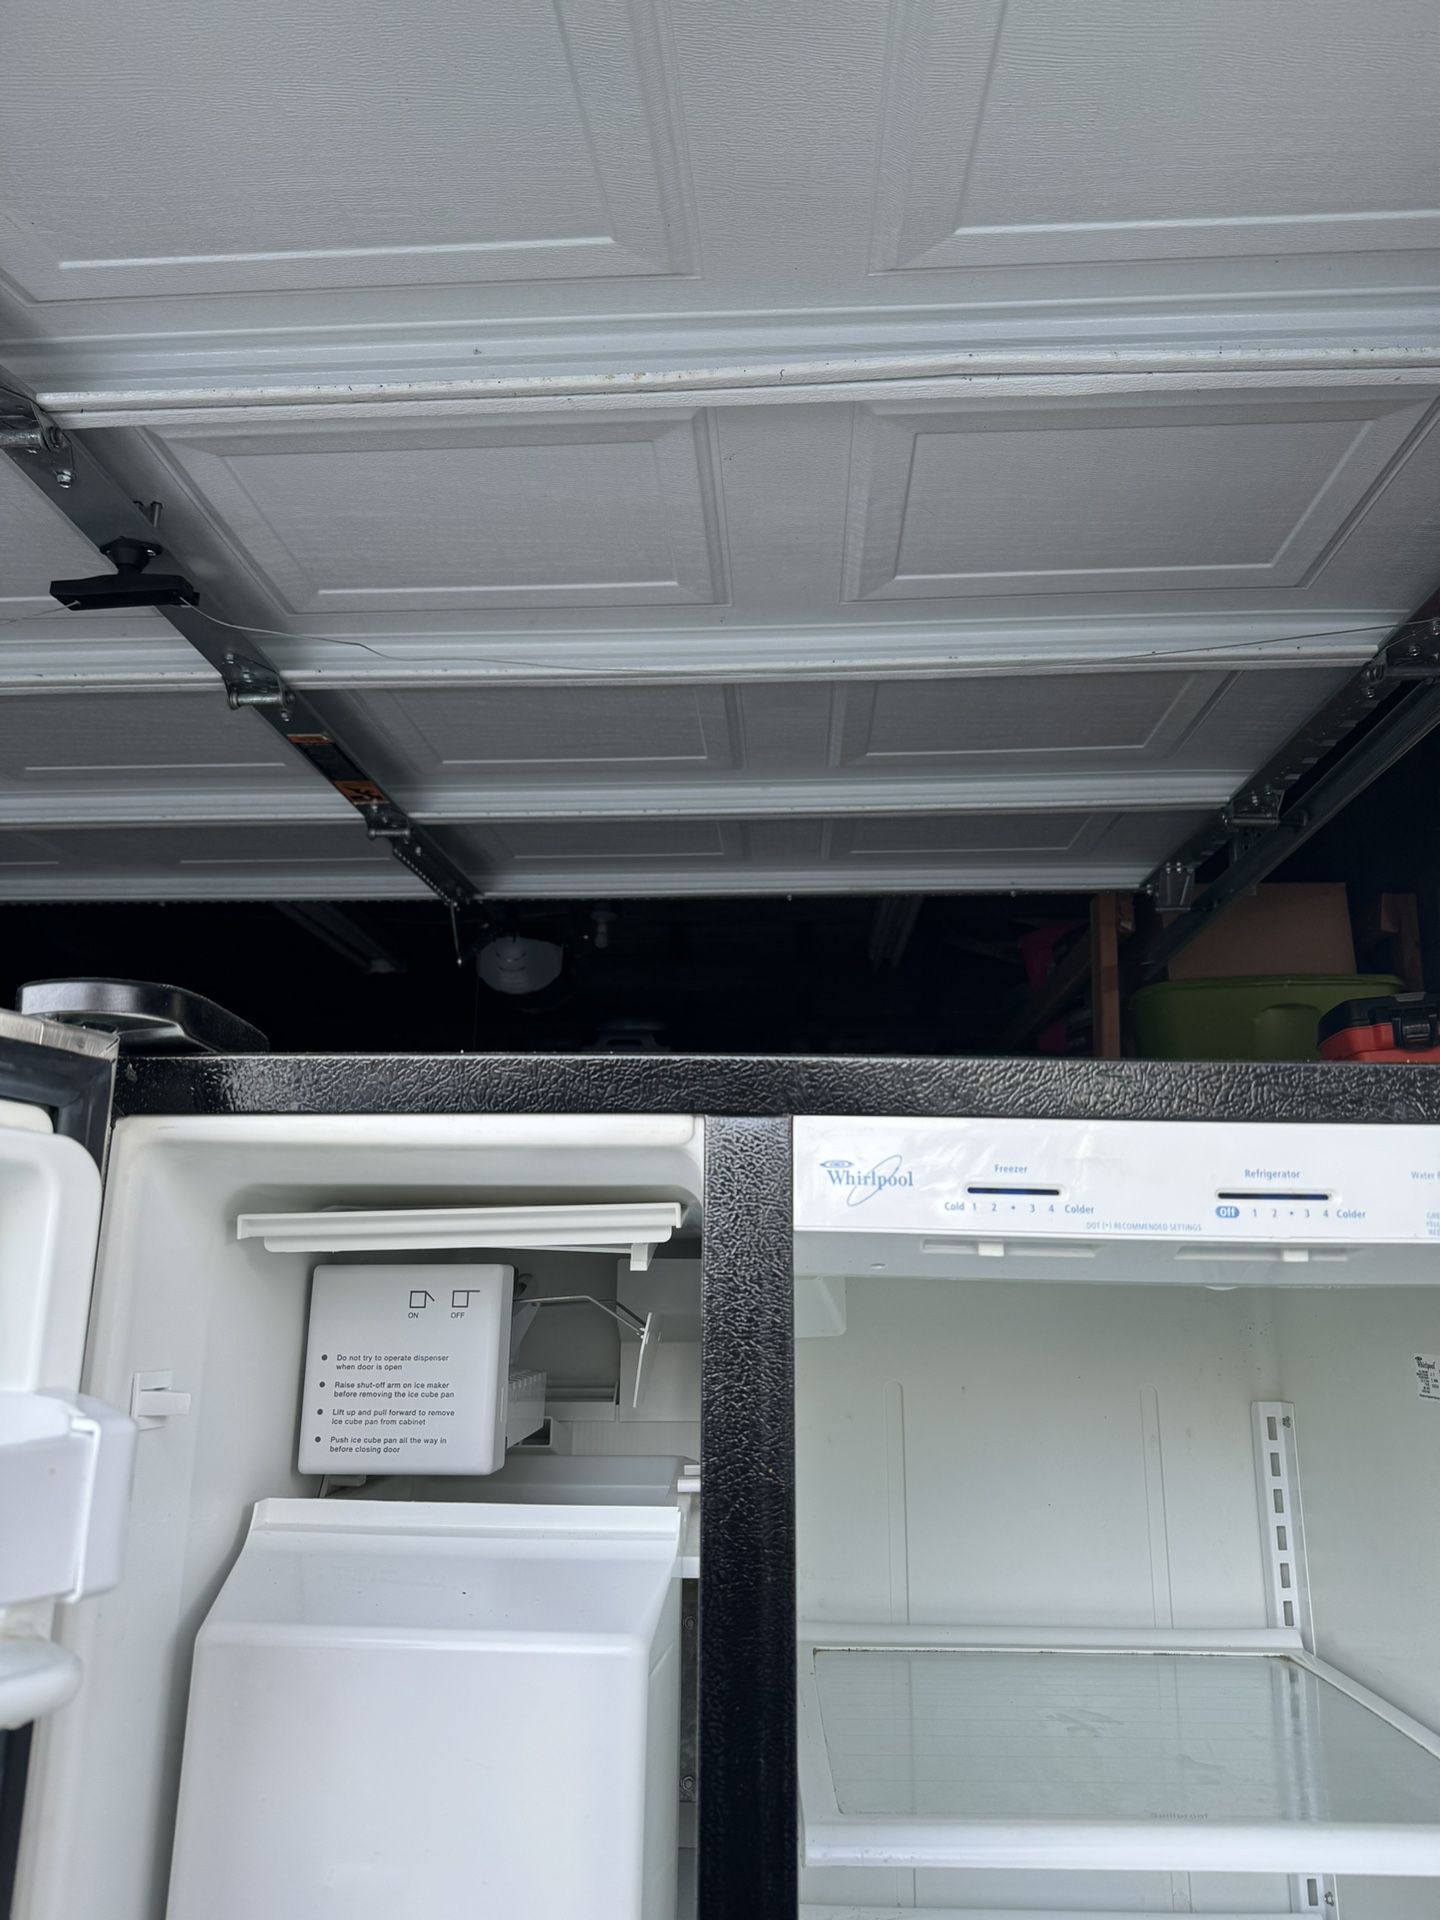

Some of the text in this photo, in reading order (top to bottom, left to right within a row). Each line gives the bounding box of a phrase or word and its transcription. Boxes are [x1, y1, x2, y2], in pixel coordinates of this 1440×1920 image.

[994, 1164, 1028, 1174] Freezer
[1244, 1169, 1300, 1180] Refrigerator
[1411, 1171, 1435, 1179] Water
[827, 1169, 913, 1190] Whirlpool
[944, 1202, 1094, 1214] Cold 1 2 3 4 Colder
[1253, 1209, 1257, 1217] 1
[1272, 1209, 1277, 1217] 2
[1304, 1210, 1310, 1218] 3
[1323, 1210, 1329, 1218] 4
[1337, 1210, 1366, 1219] Colder
[1114, 1223, 1168, 1231] RECOMMENDED
[363, 1355, 372, 1363] try
[384, 1355, 411, 1363] operate
[414, 1354, 449, 1363] dispenser
[359, 1391, 392, 1399] removing
[347, 1410, 356, 1418] up
[373, 1409, 387, 1417] pull
[355, 1446, 381, 1454] closing
